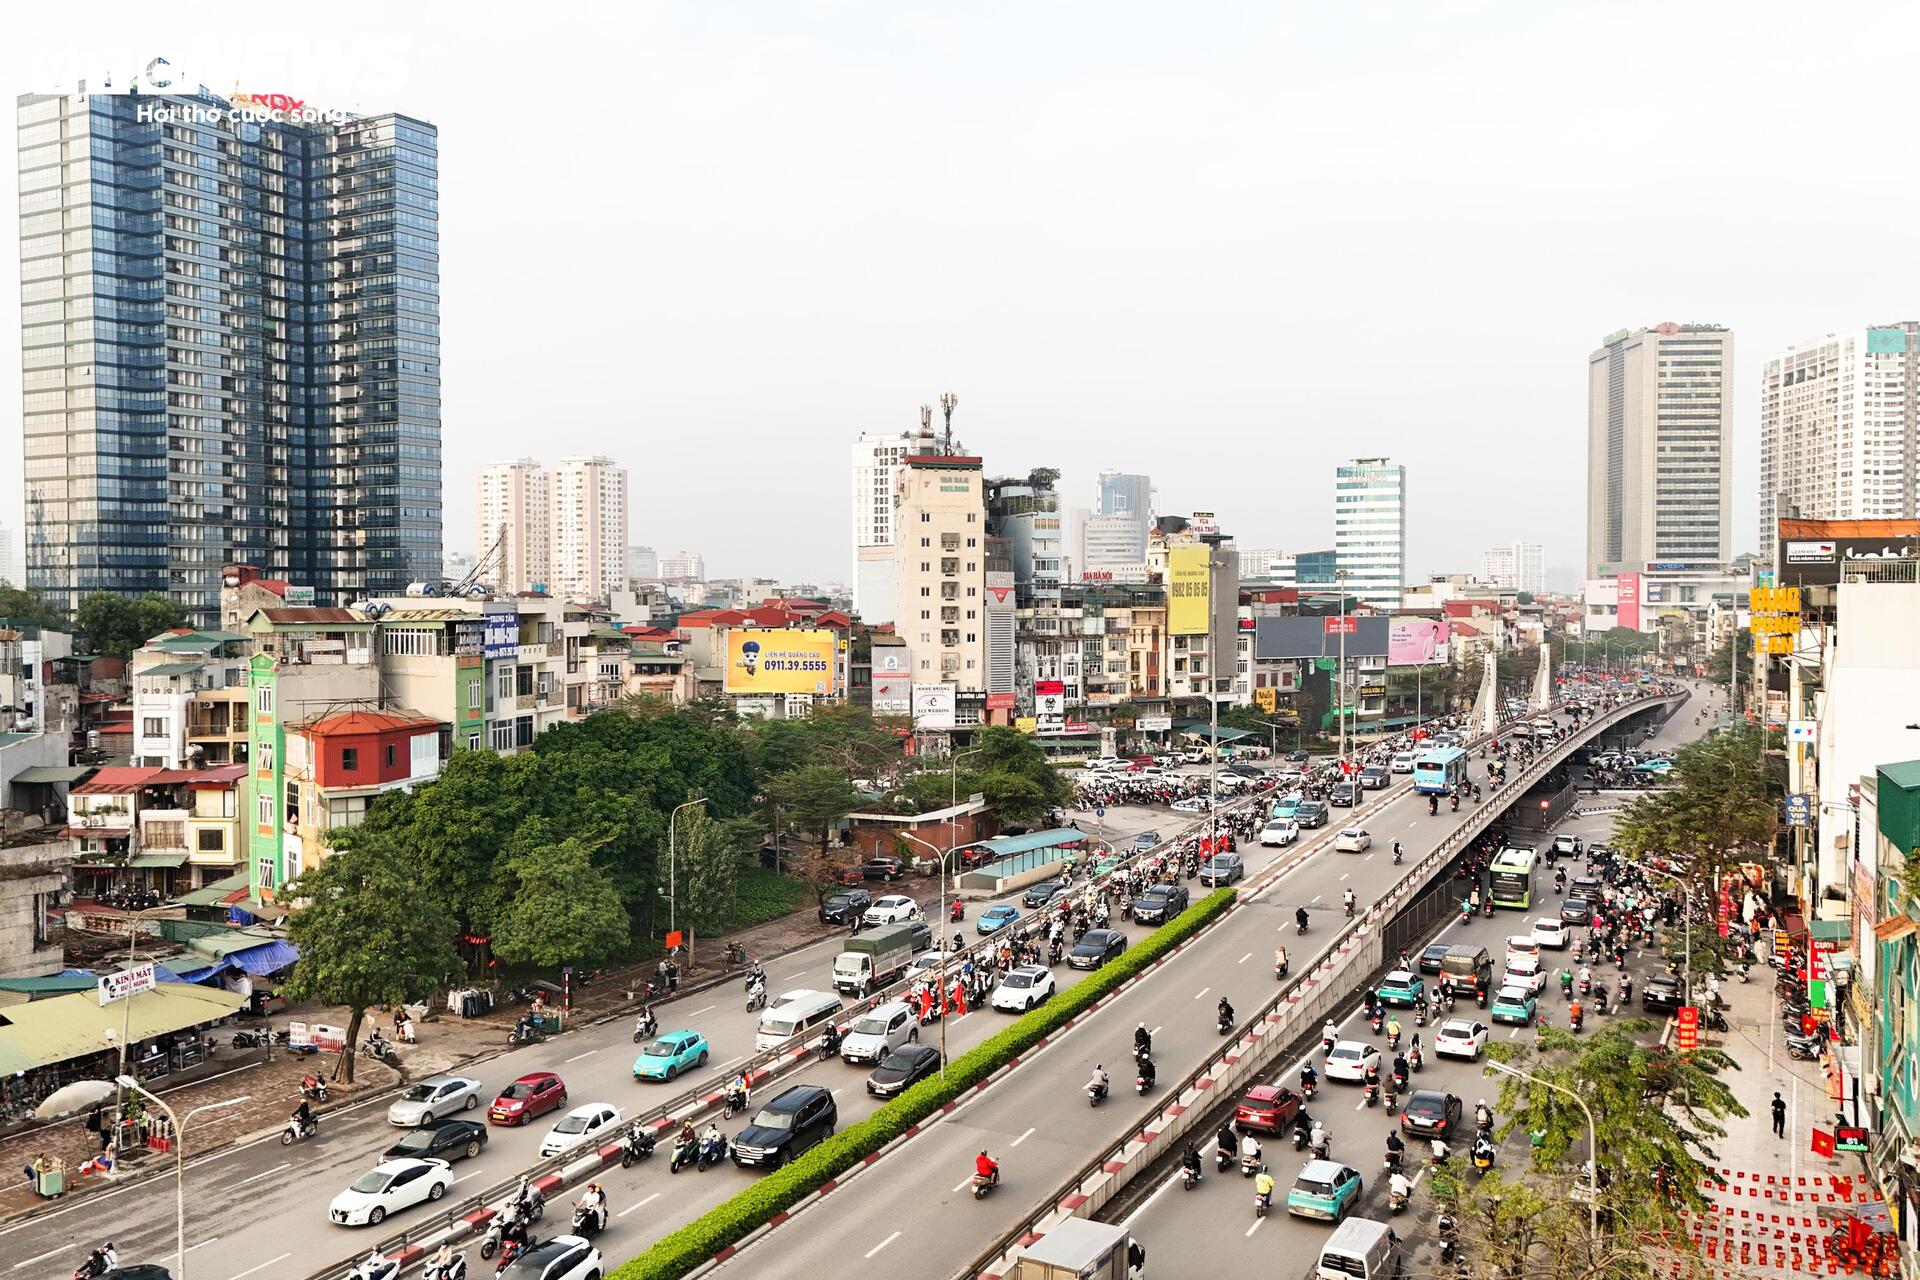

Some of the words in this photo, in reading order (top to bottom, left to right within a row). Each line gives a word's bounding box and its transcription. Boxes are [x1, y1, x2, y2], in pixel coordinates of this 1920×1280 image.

[1083, 571, 1093, 581] BIA
[1093, 570, 1101, 580] HÀ
[1102, 570, 1113, 582] NỘI
[765, 660, 827, 671] 0911.39.5555
[115, 972, 135, 986] KÍNH
[136, 966, 152, 979] MẮT
